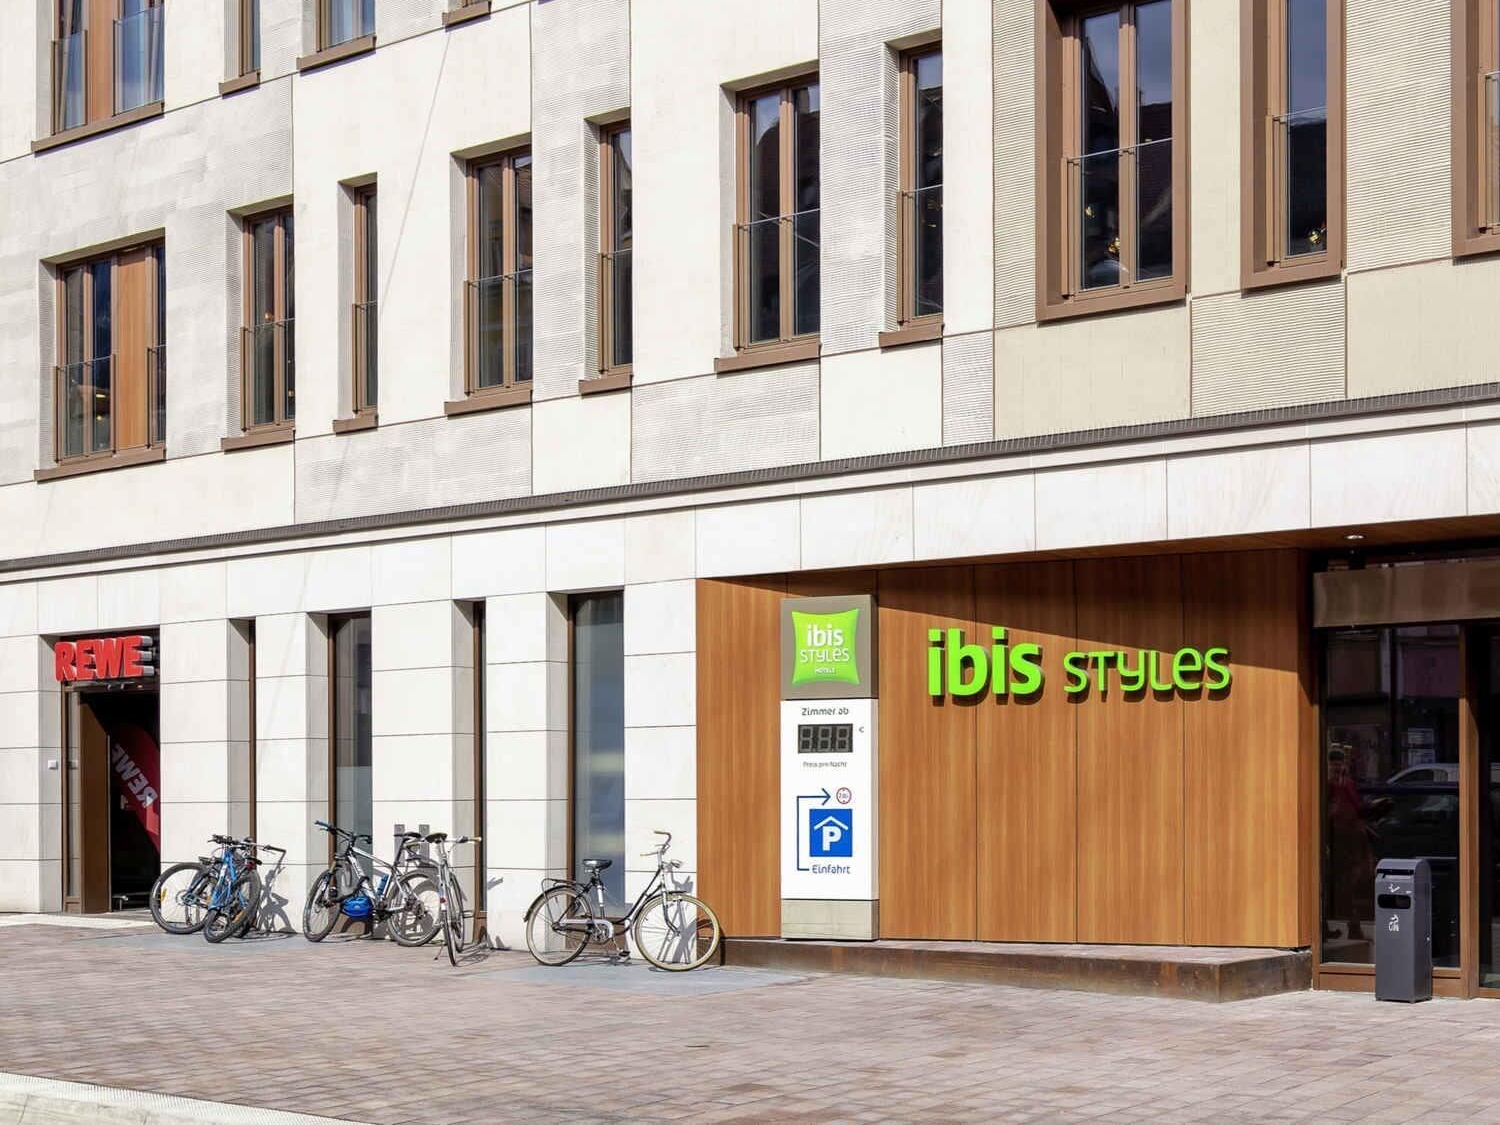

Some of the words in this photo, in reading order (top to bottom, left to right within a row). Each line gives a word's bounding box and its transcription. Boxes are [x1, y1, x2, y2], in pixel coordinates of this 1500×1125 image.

[807, 623, 844, 647] ibis
[54, 635, 148, 682] REWE
[928, 626, 1043, 696] ibis
[801, 707, 836, 716] Zimmer
[838, 706, 849, 715] ab
[822, 825, 842, 851] P
[812, 864, 851, 874] Einfahrt
